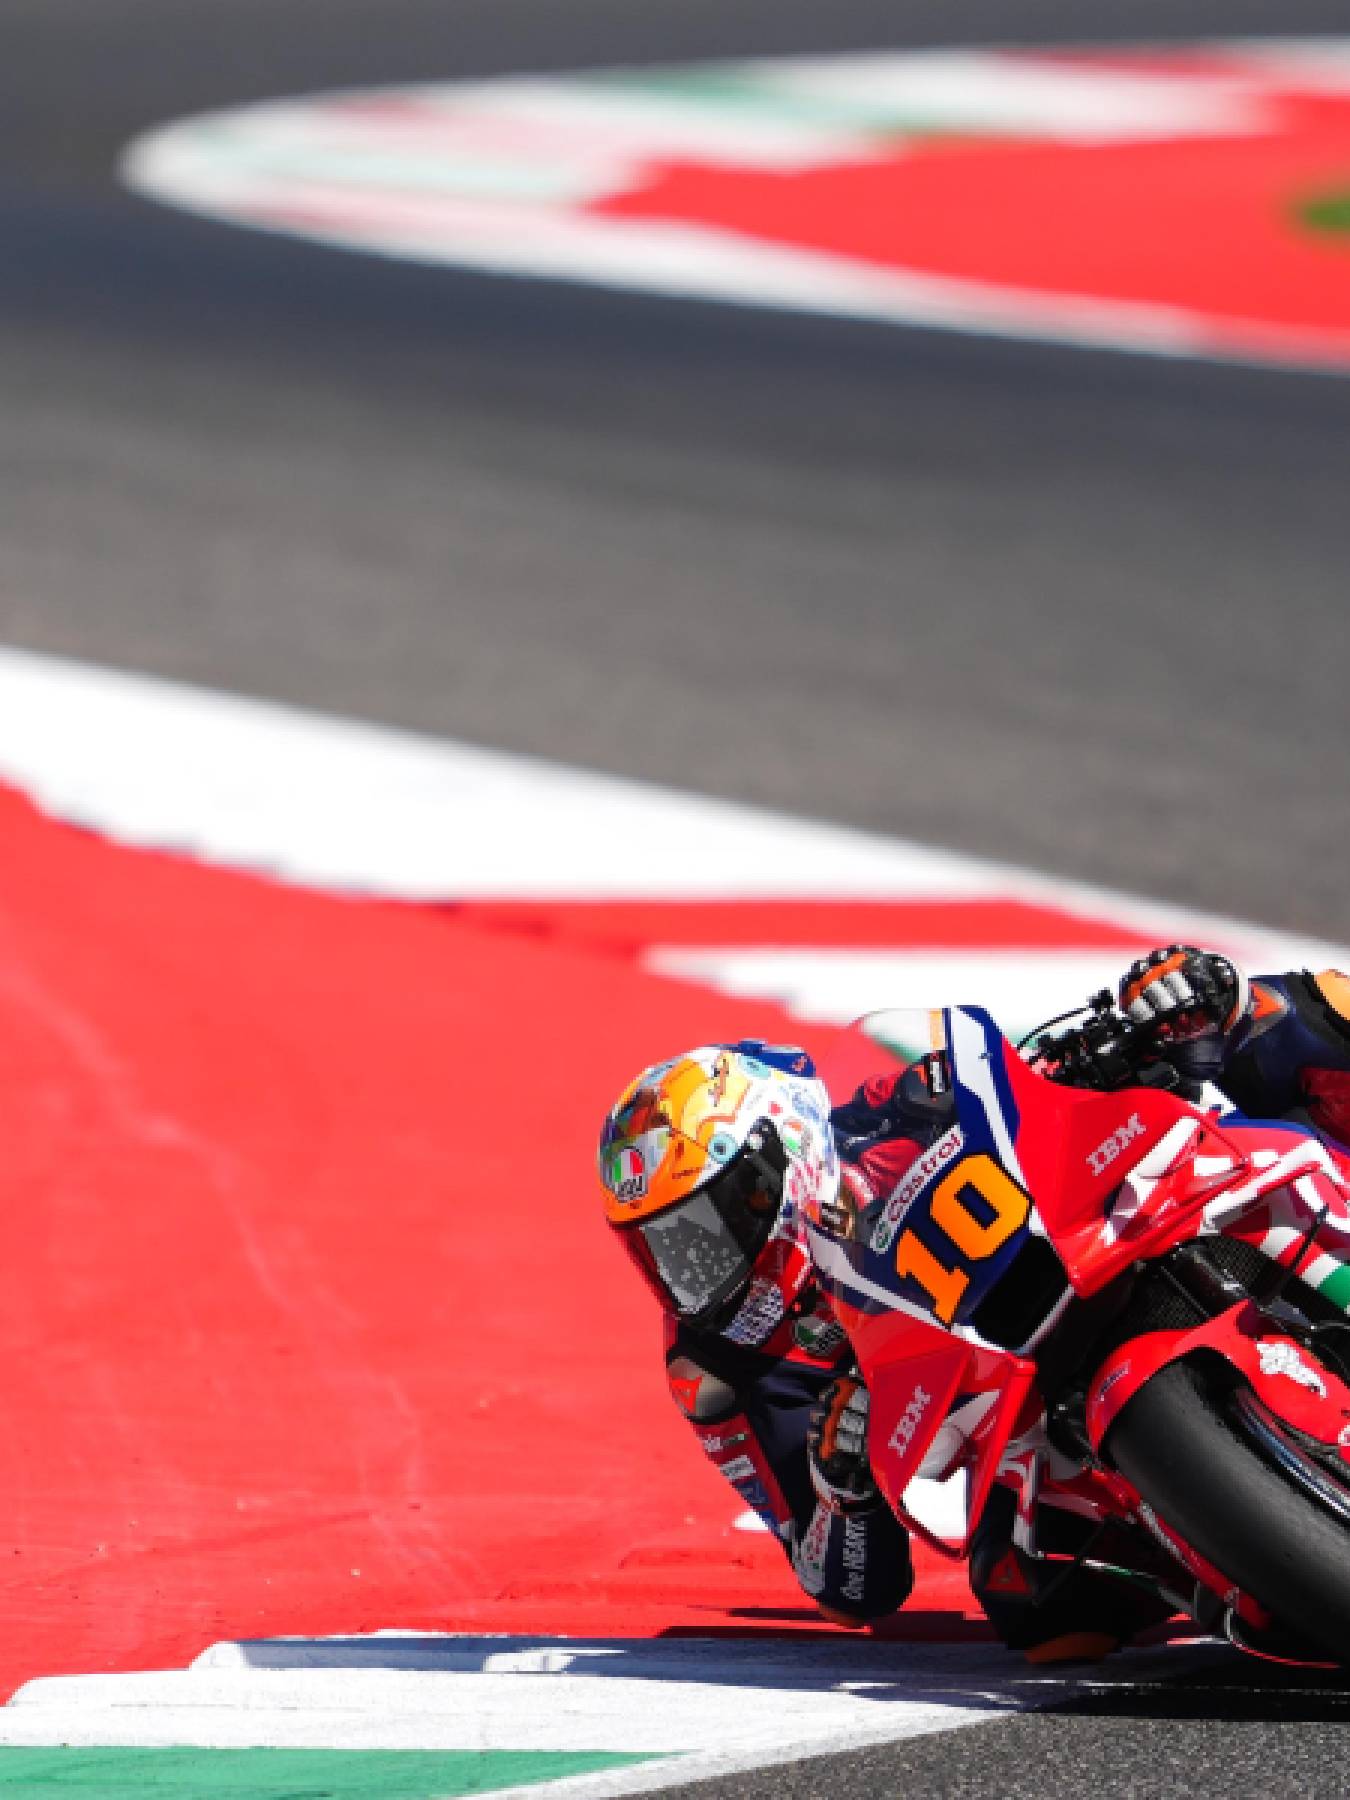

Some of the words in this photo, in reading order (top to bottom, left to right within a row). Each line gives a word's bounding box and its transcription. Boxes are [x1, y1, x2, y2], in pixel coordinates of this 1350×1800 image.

[889, 1130, 962, 1223] Castrol
[1086, 1113, 1147, 1176] IBM
[896, 1155, 1032, 1326] 10
[888, 1384, 931, 1458] IBM
